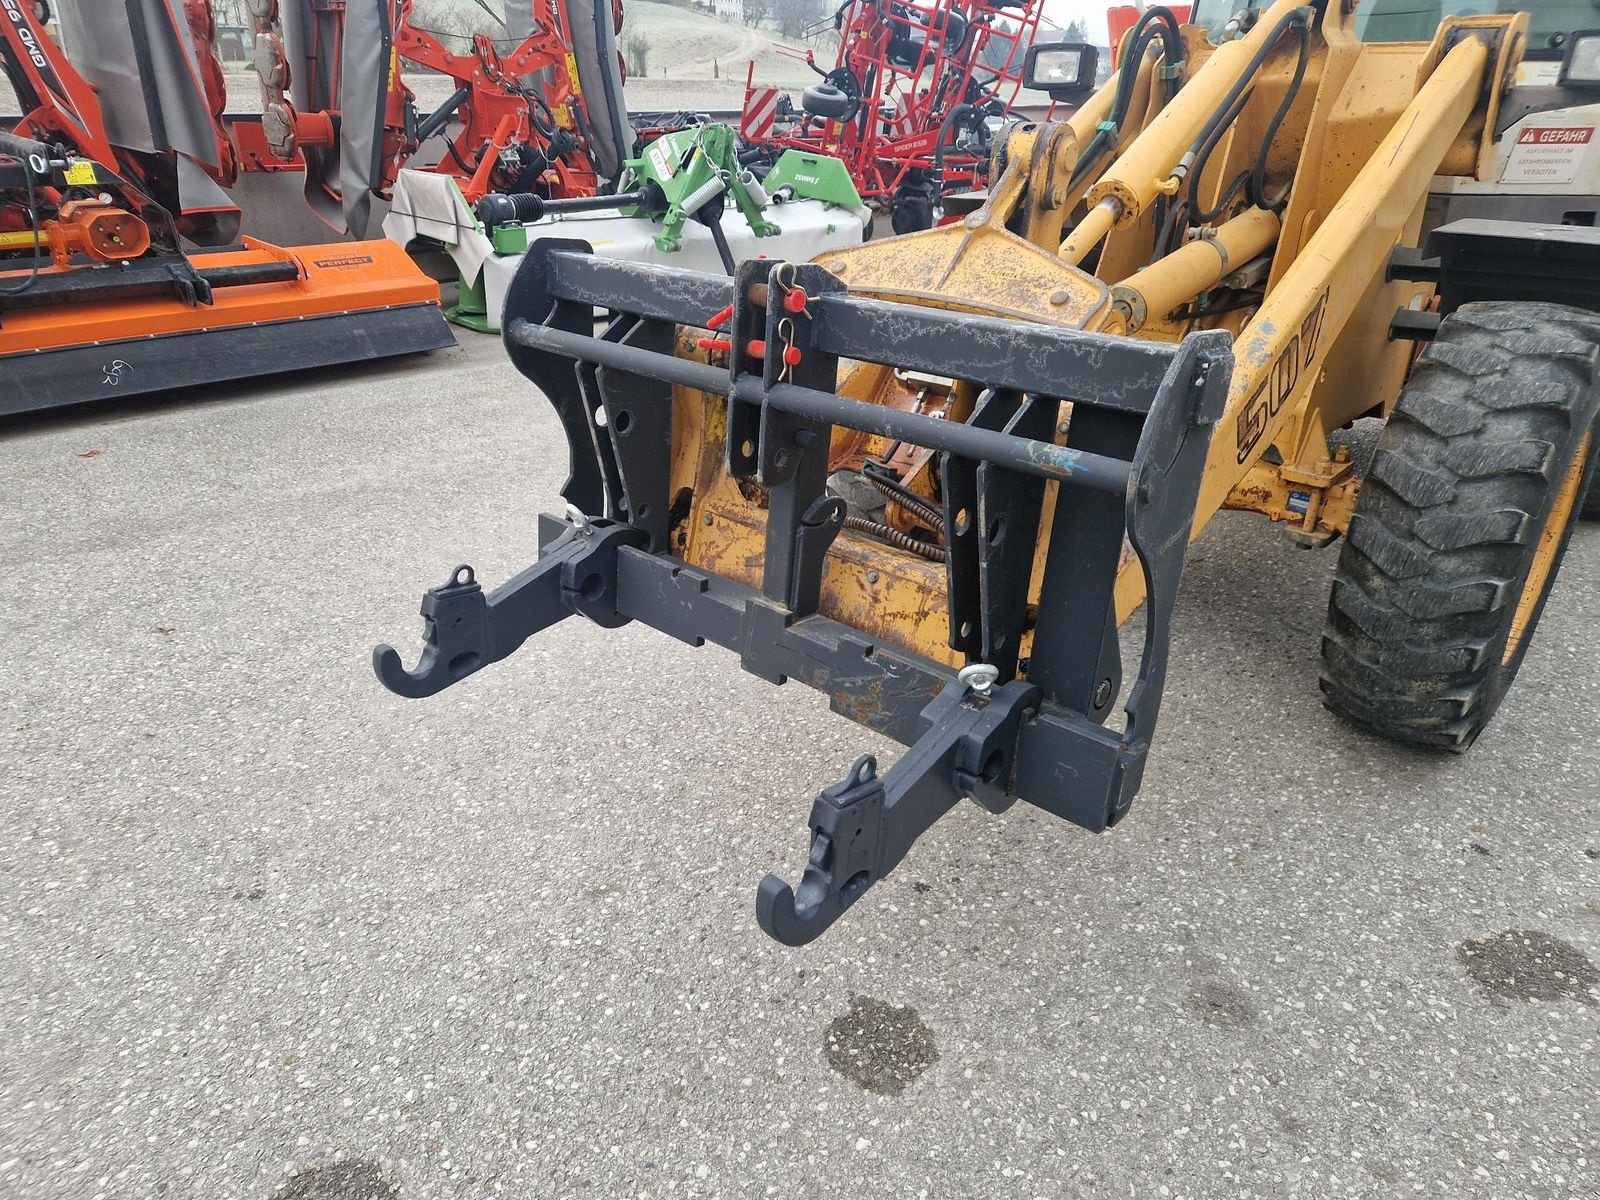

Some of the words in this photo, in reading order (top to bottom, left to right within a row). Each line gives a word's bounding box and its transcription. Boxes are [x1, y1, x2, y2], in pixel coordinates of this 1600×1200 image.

[19, 28, 46, 67] GMD
[1540, 130, 1587, 142] GEFAHR
[1523, 168, 1557, 176] VERBOTEN
[319, 257, 368, 267] PERFECT
[1237, 285, 1330, 465] 507
